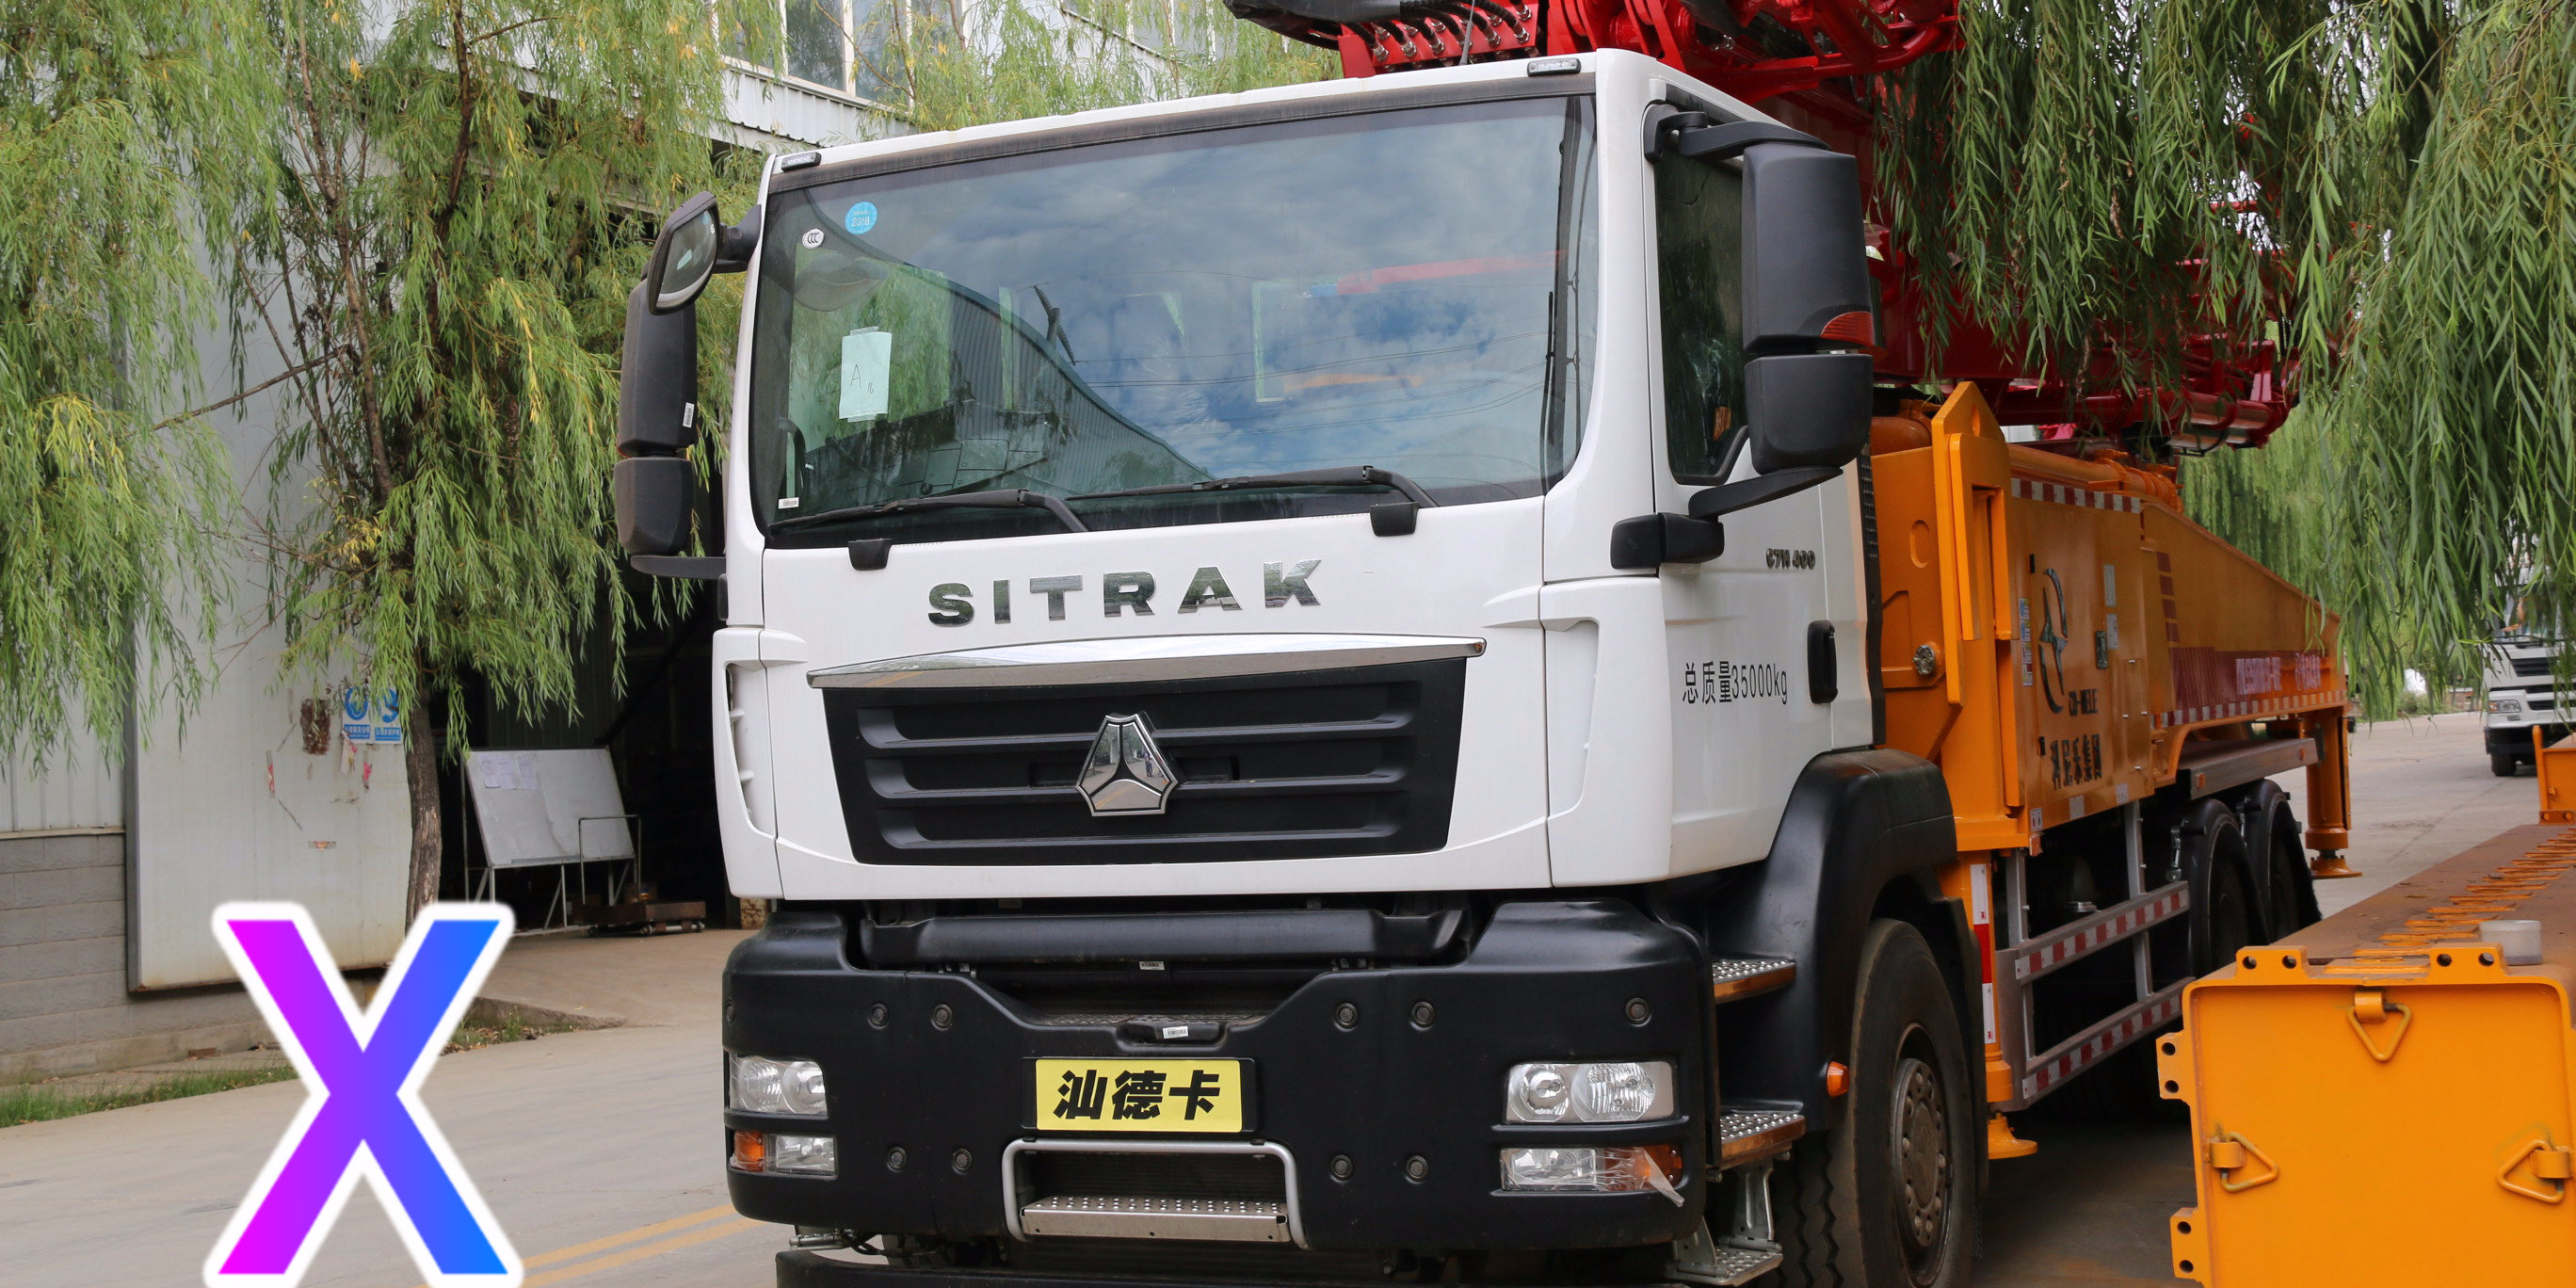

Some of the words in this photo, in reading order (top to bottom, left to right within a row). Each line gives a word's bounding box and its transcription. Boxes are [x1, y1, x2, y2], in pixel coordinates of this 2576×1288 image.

[851, 217, 870, 228] 2018
[850, 363, 861, 390] A
[1766, 548, 1791, 570] C7H
[1793, 549, 1816, 570] 400
[927, 559, 1322, 628] SITRAK
[1682, 661, 1788, 705] 总质量35000kg
[1053, 1070, 1221, 1120] 汕德卡
